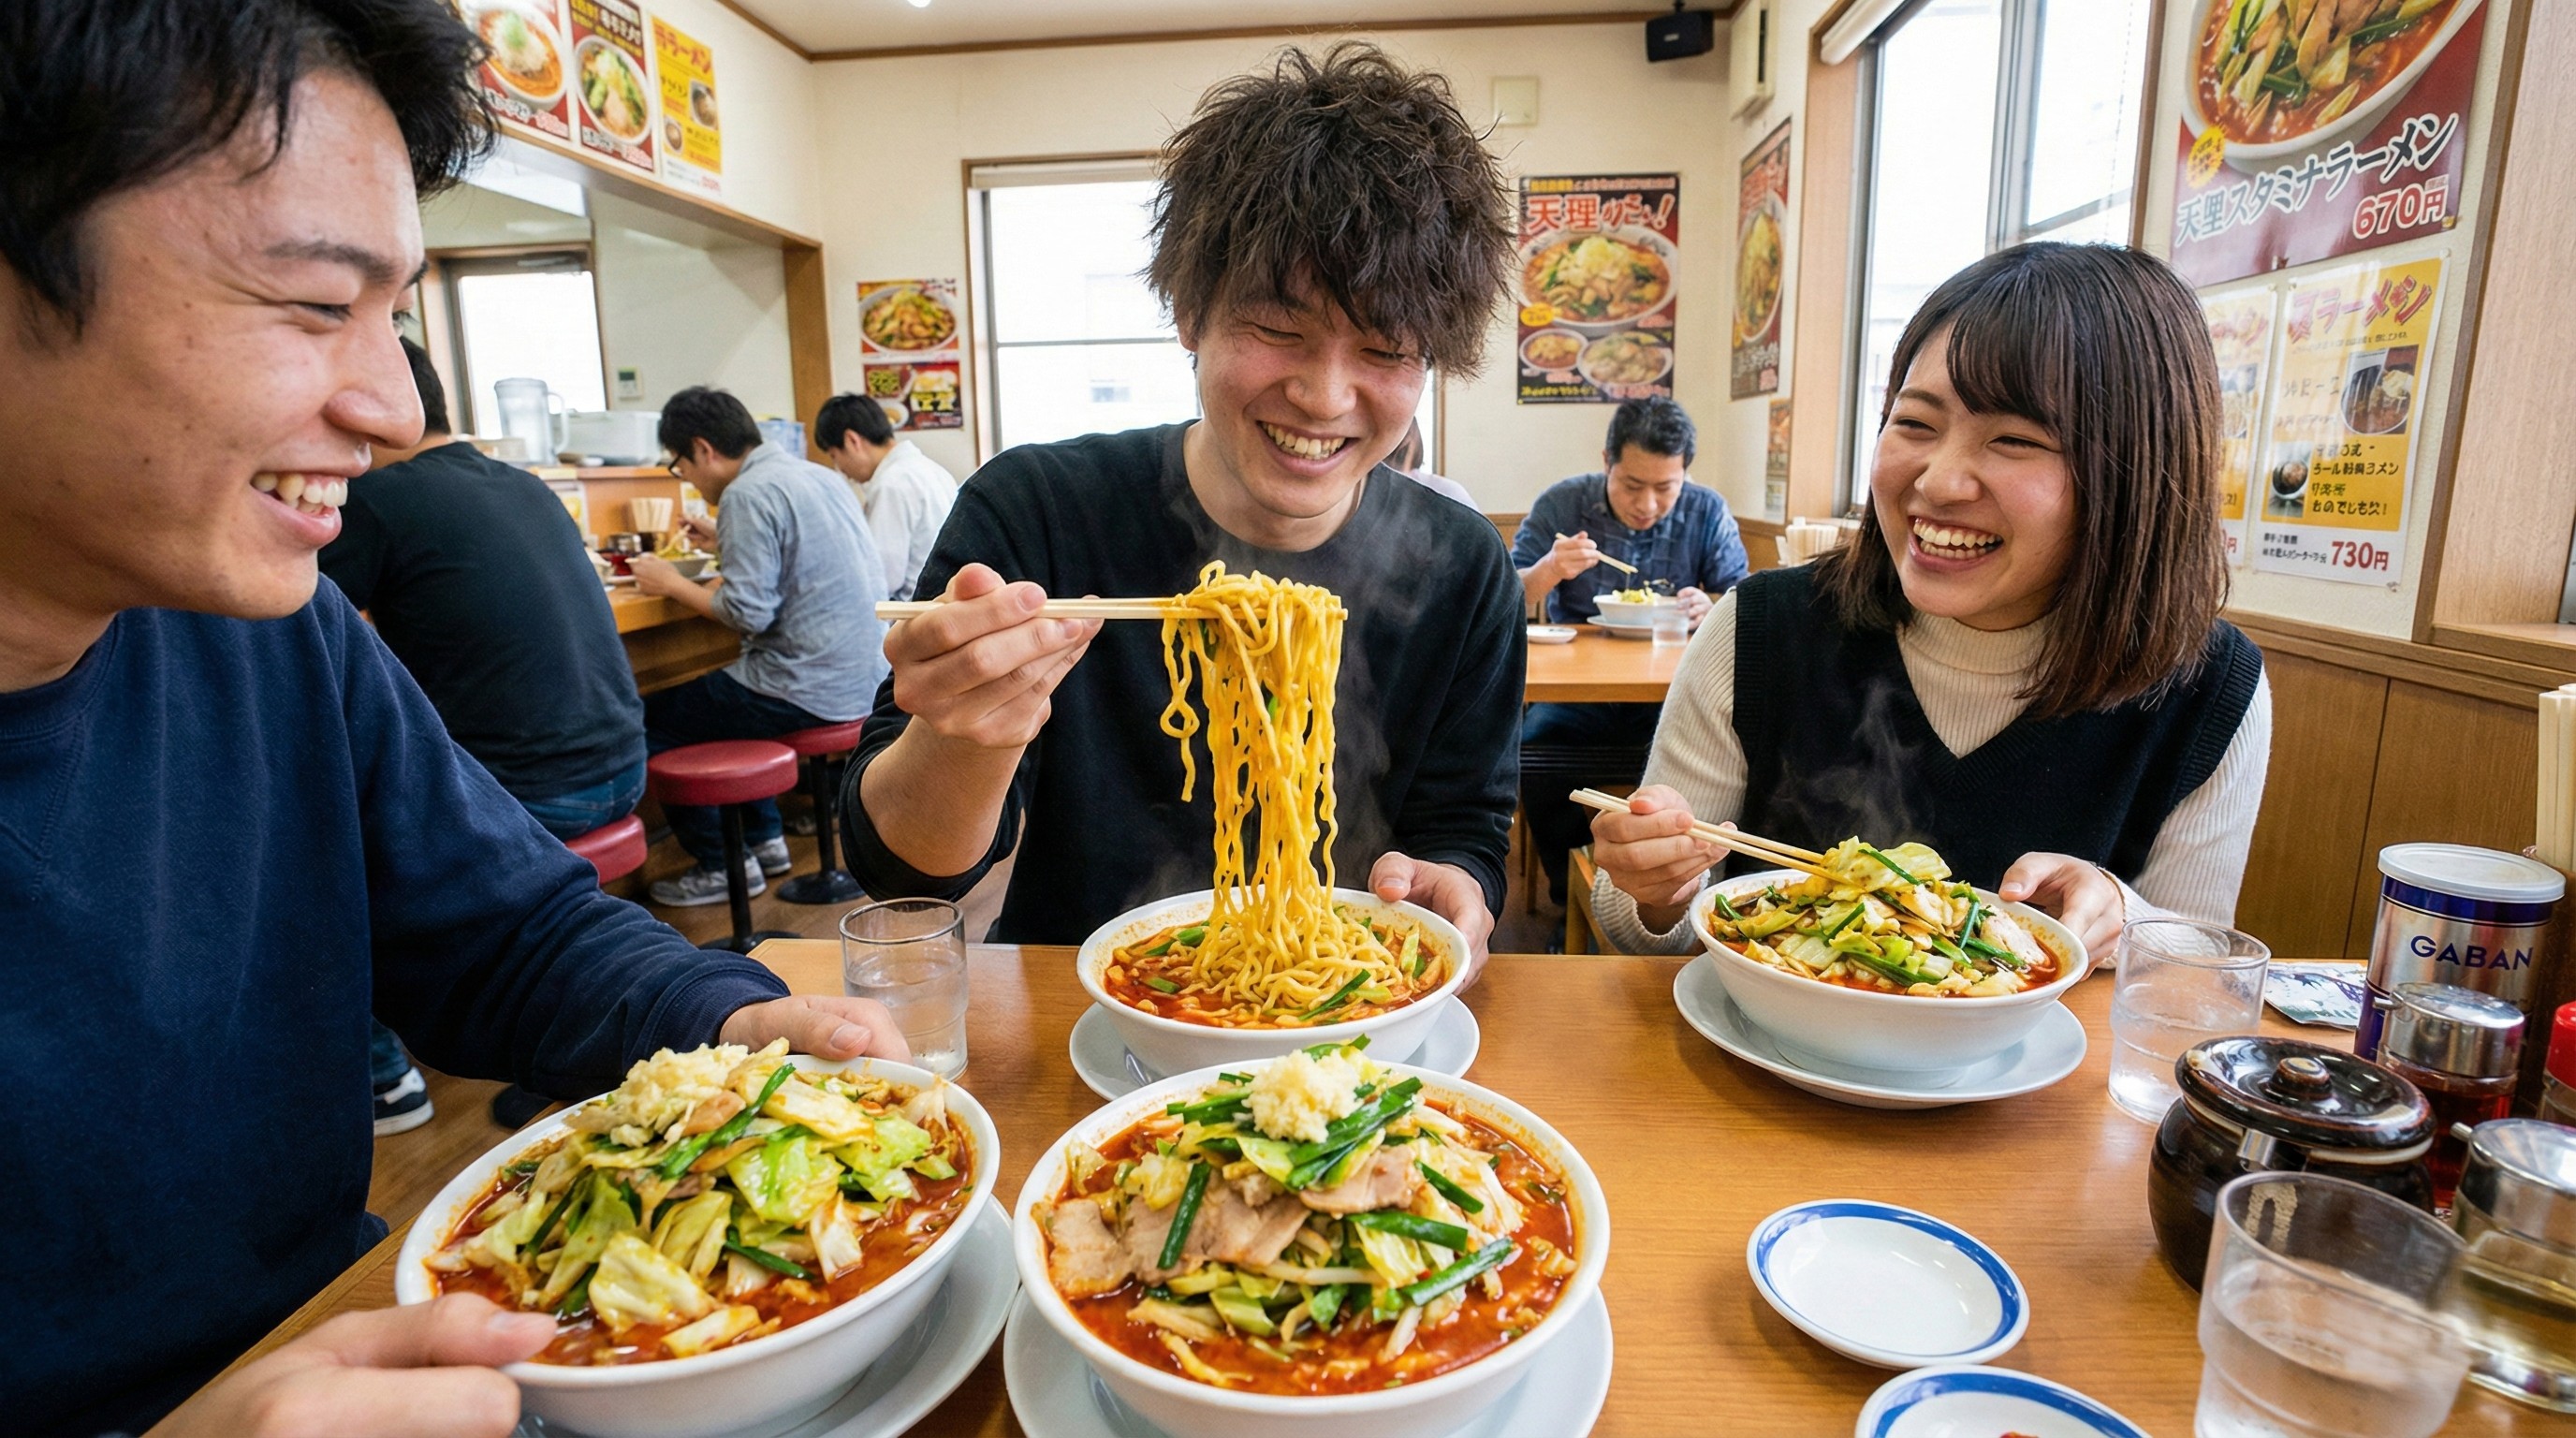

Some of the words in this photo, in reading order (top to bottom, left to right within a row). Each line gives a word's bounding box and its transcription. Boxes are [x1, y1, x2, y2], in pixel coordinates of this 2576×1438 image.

[2354, 184, 2447, 239] 670円
[2332, 541, 2389, 571] 730円
[2410, 935, 2534, 971] GABAN
